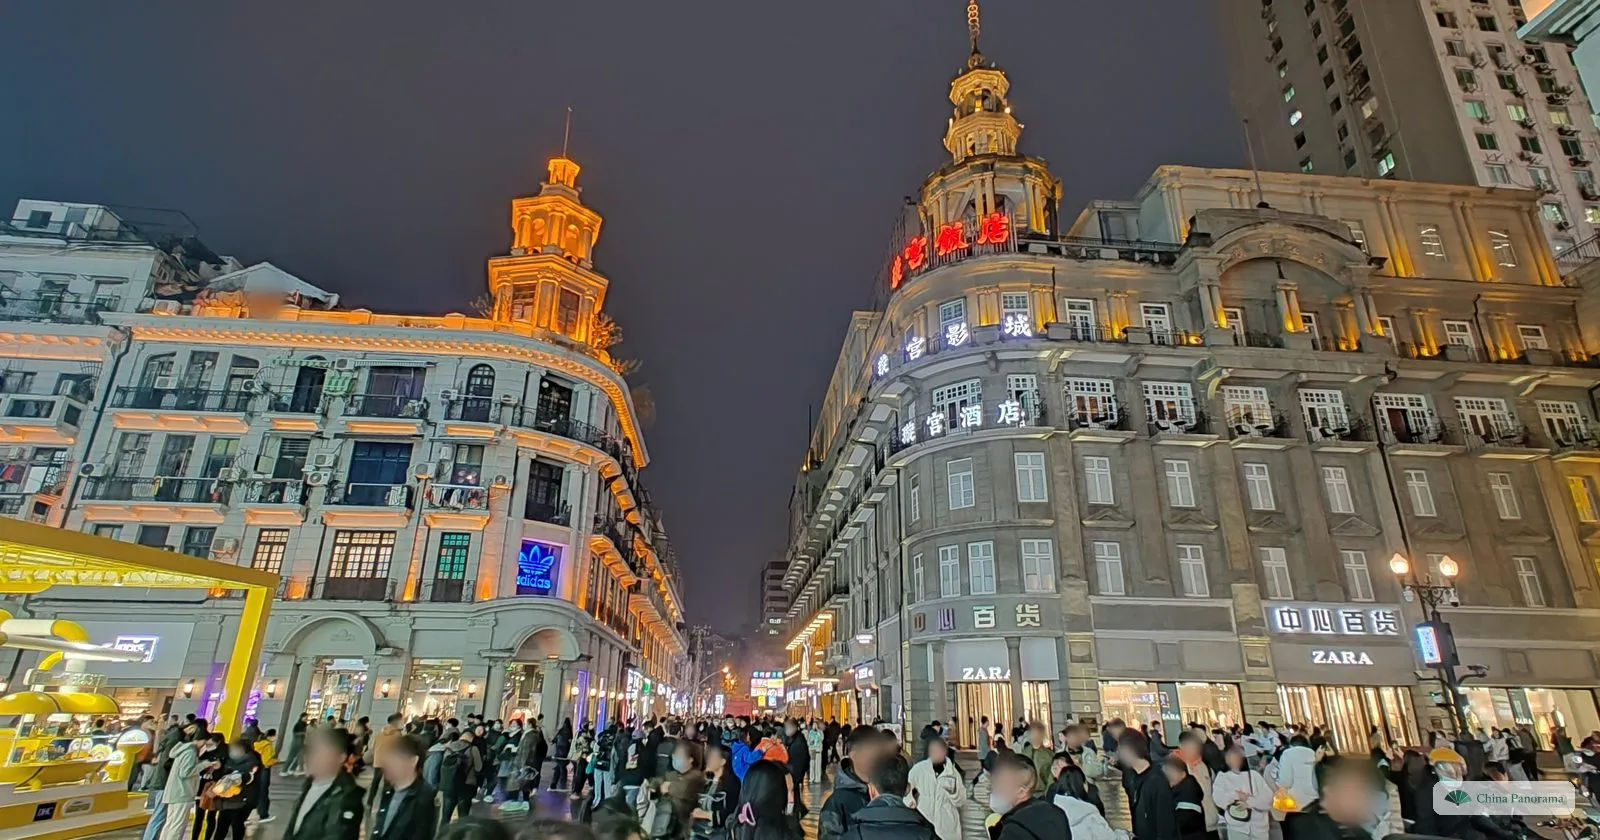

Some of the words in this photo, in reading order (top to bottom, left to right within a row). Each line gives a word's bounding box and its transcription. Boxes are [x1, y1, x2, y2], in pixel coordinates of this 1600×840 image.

[913, 603, 1041, 632] 中心百货
[1277, 607, 1398, 635] 中心百货
[1312, 650, 1374, 665] ZARA
